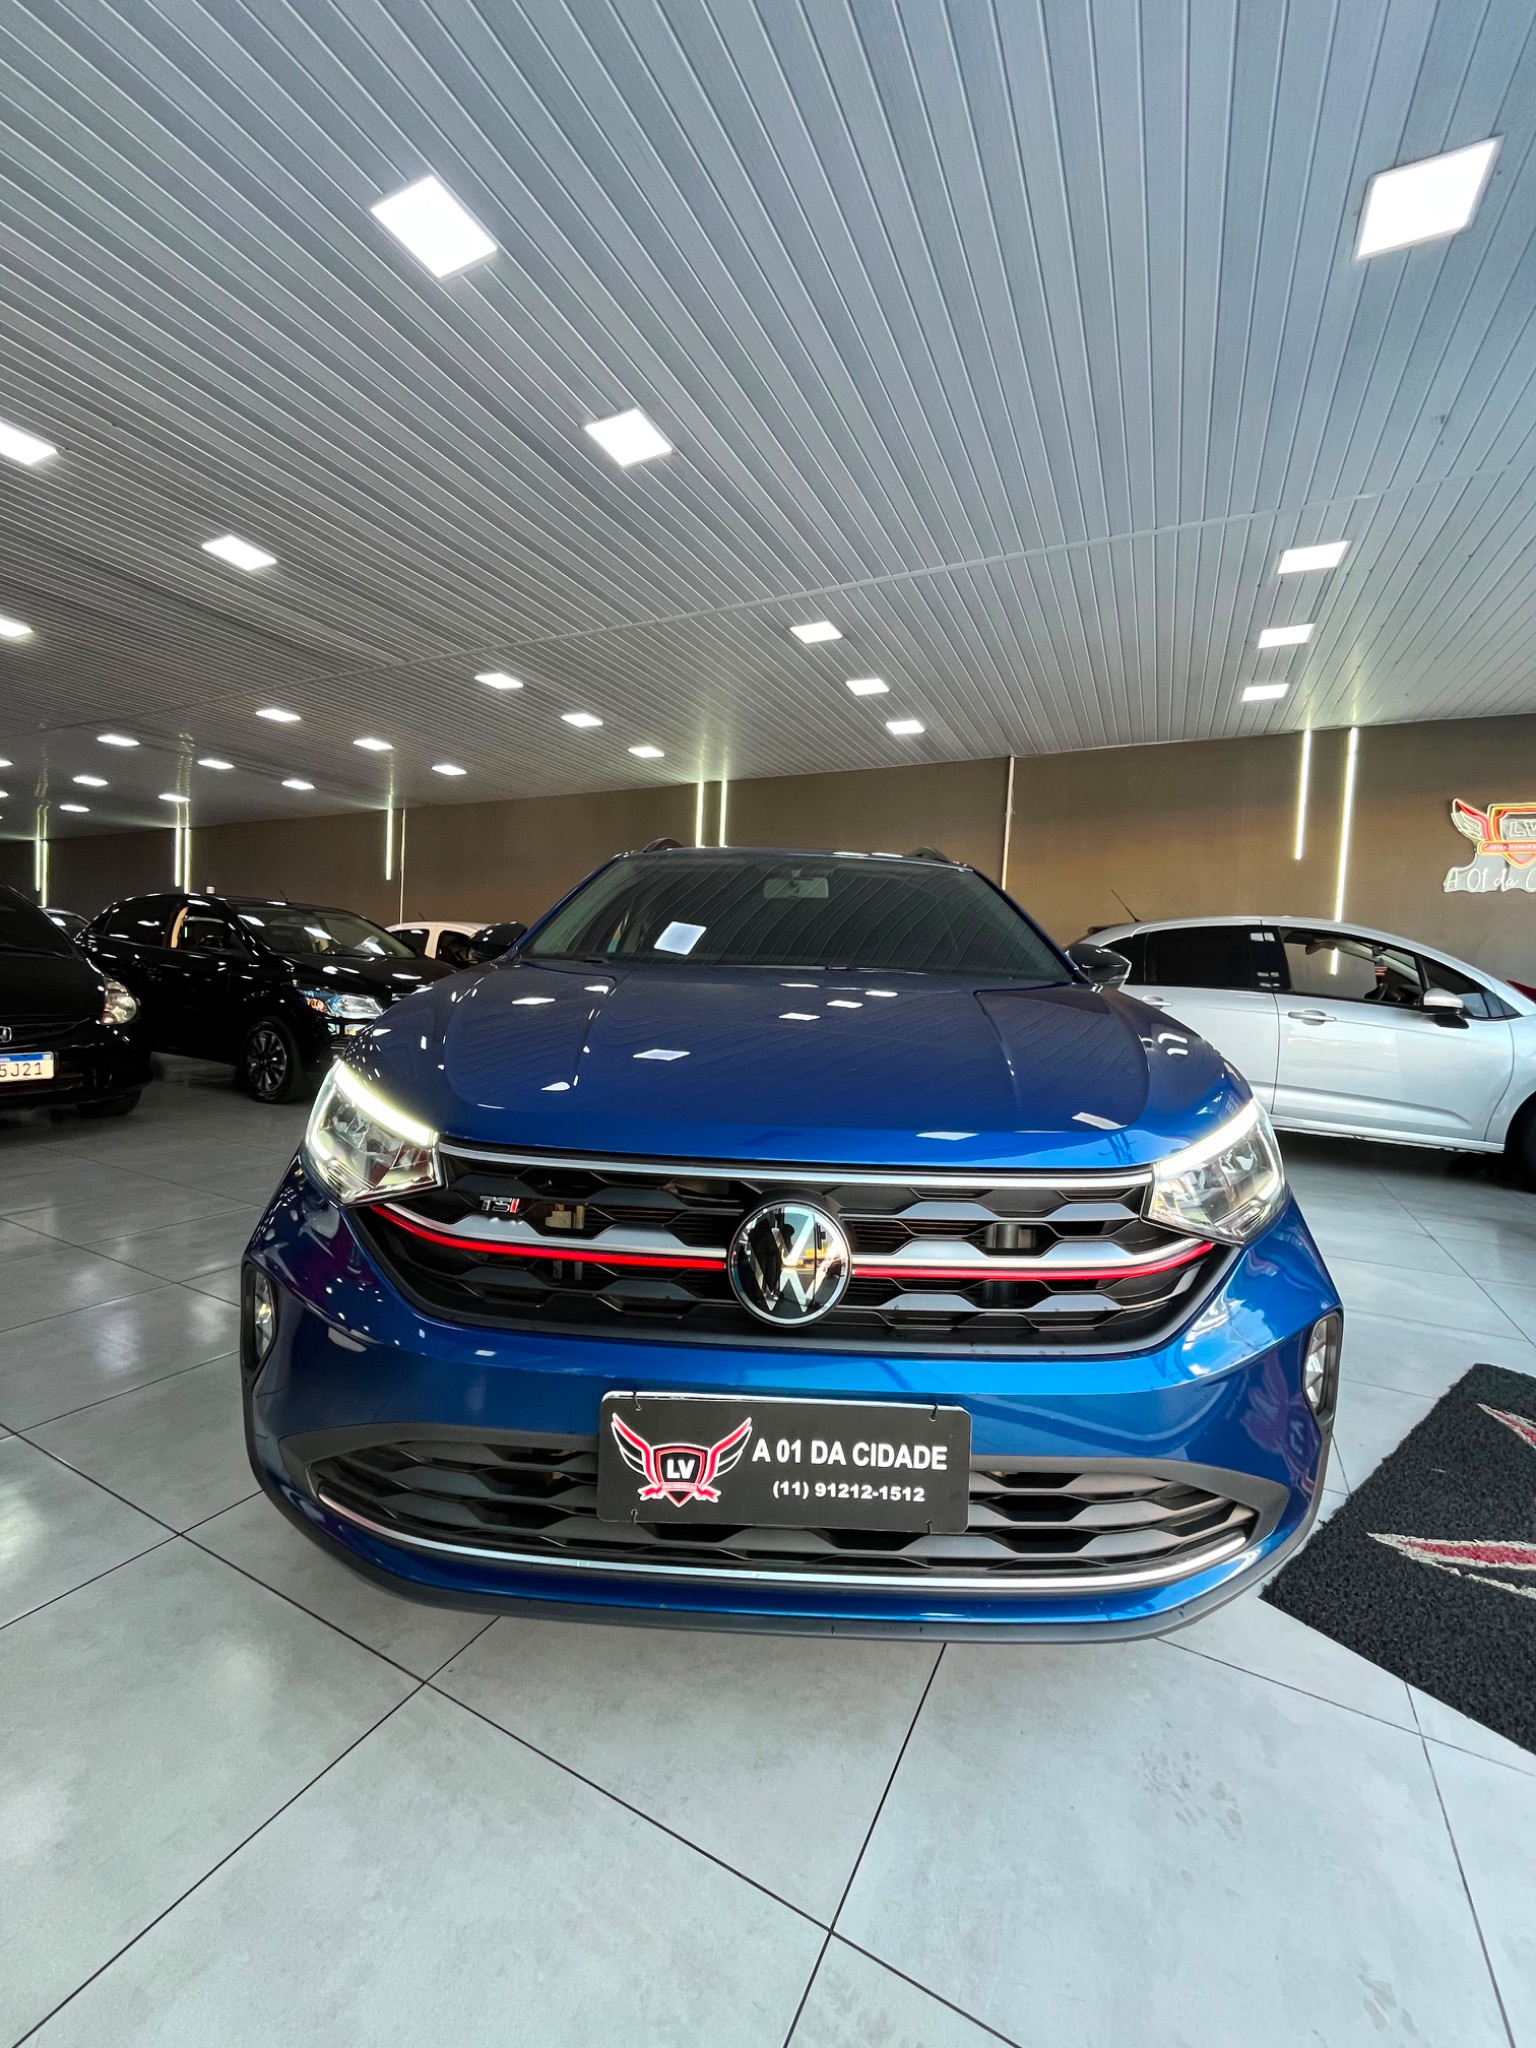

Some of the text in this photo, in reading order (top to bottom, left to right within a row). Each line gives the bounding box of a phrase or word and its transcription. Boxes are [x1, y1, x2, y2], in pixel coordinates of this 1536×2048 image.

[1446, 869, 1459, 889] A
[1493, 867, 1520, 892] da
[0, 1062, 42, 1078] 5J21
[480, 1195, 520, 1213] TSI
[752, 1438, 948, 1471] A 01 DA CIDADE
[667, 1459, 696, 1479] LV
[772, 1480, 925, 1502] (11) 91212-1512
